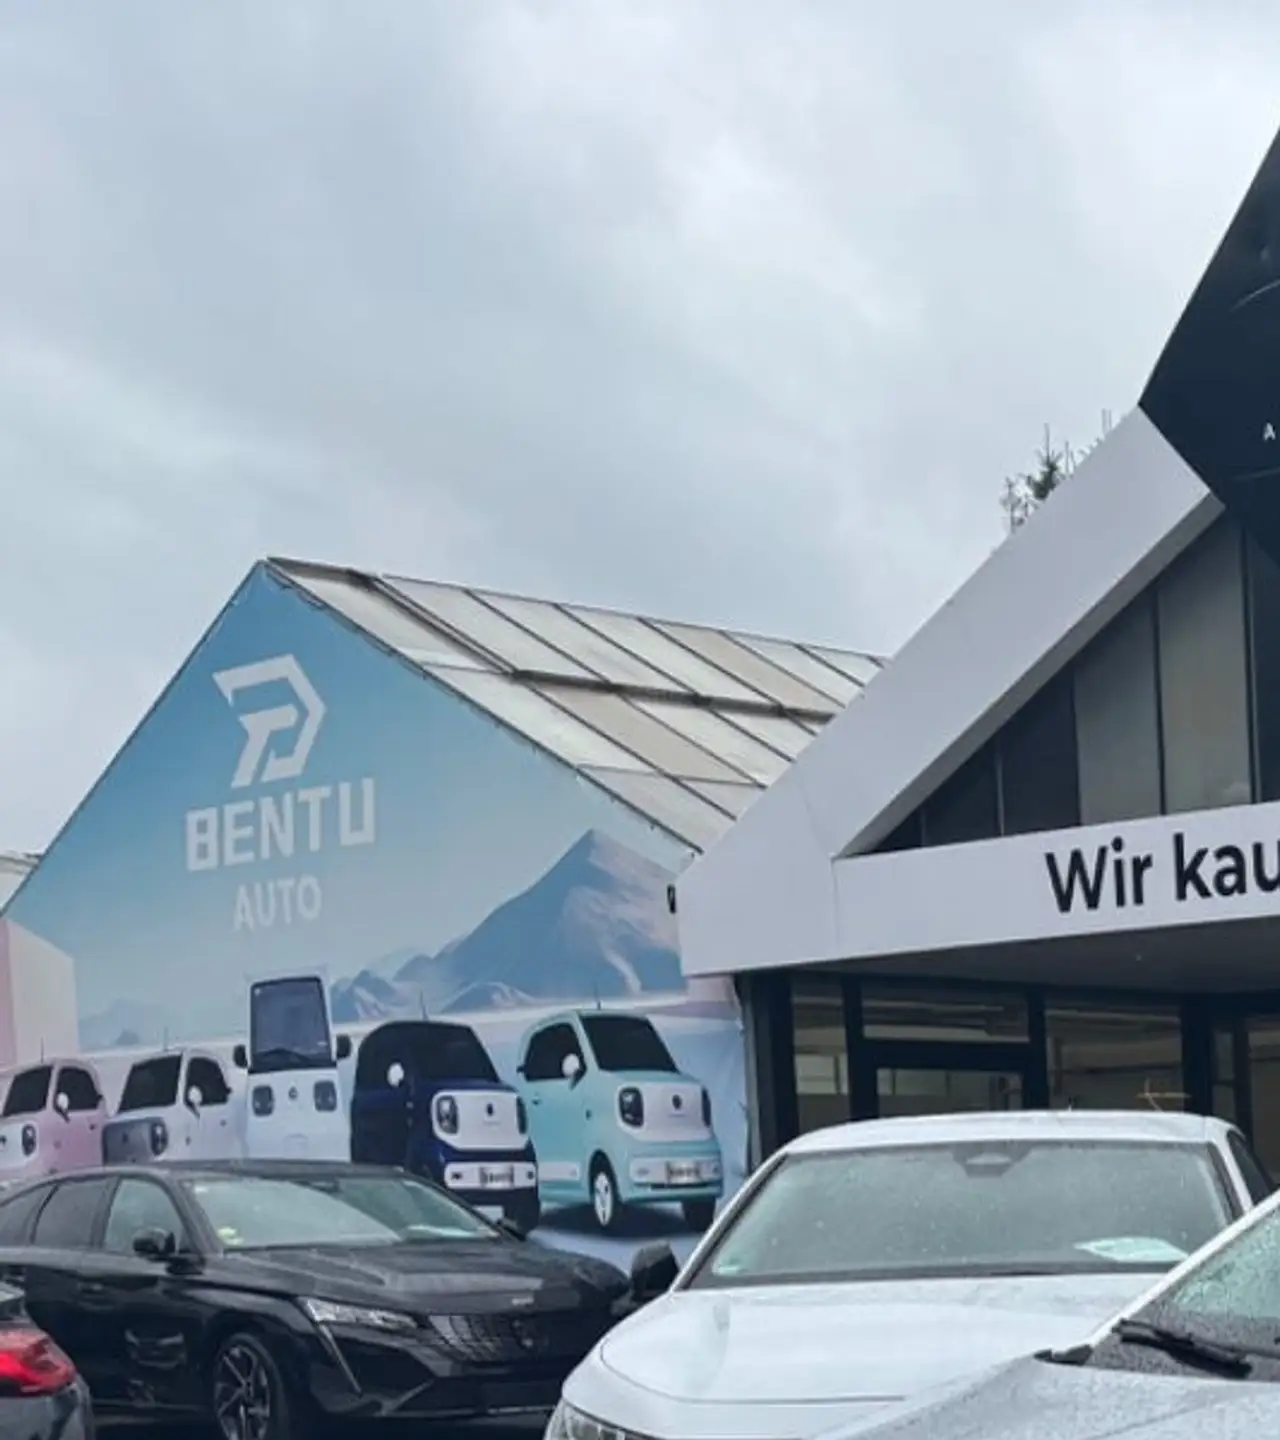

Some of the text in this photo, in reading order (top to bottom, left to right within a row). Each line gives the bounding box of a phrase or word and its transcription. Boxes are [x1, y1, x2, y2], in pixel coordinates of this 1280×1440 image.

[186, 777, 378, 872] BENTU
[232, 875, 323, 932] AUTO
[1046, 837, 1153, 913] Wir
